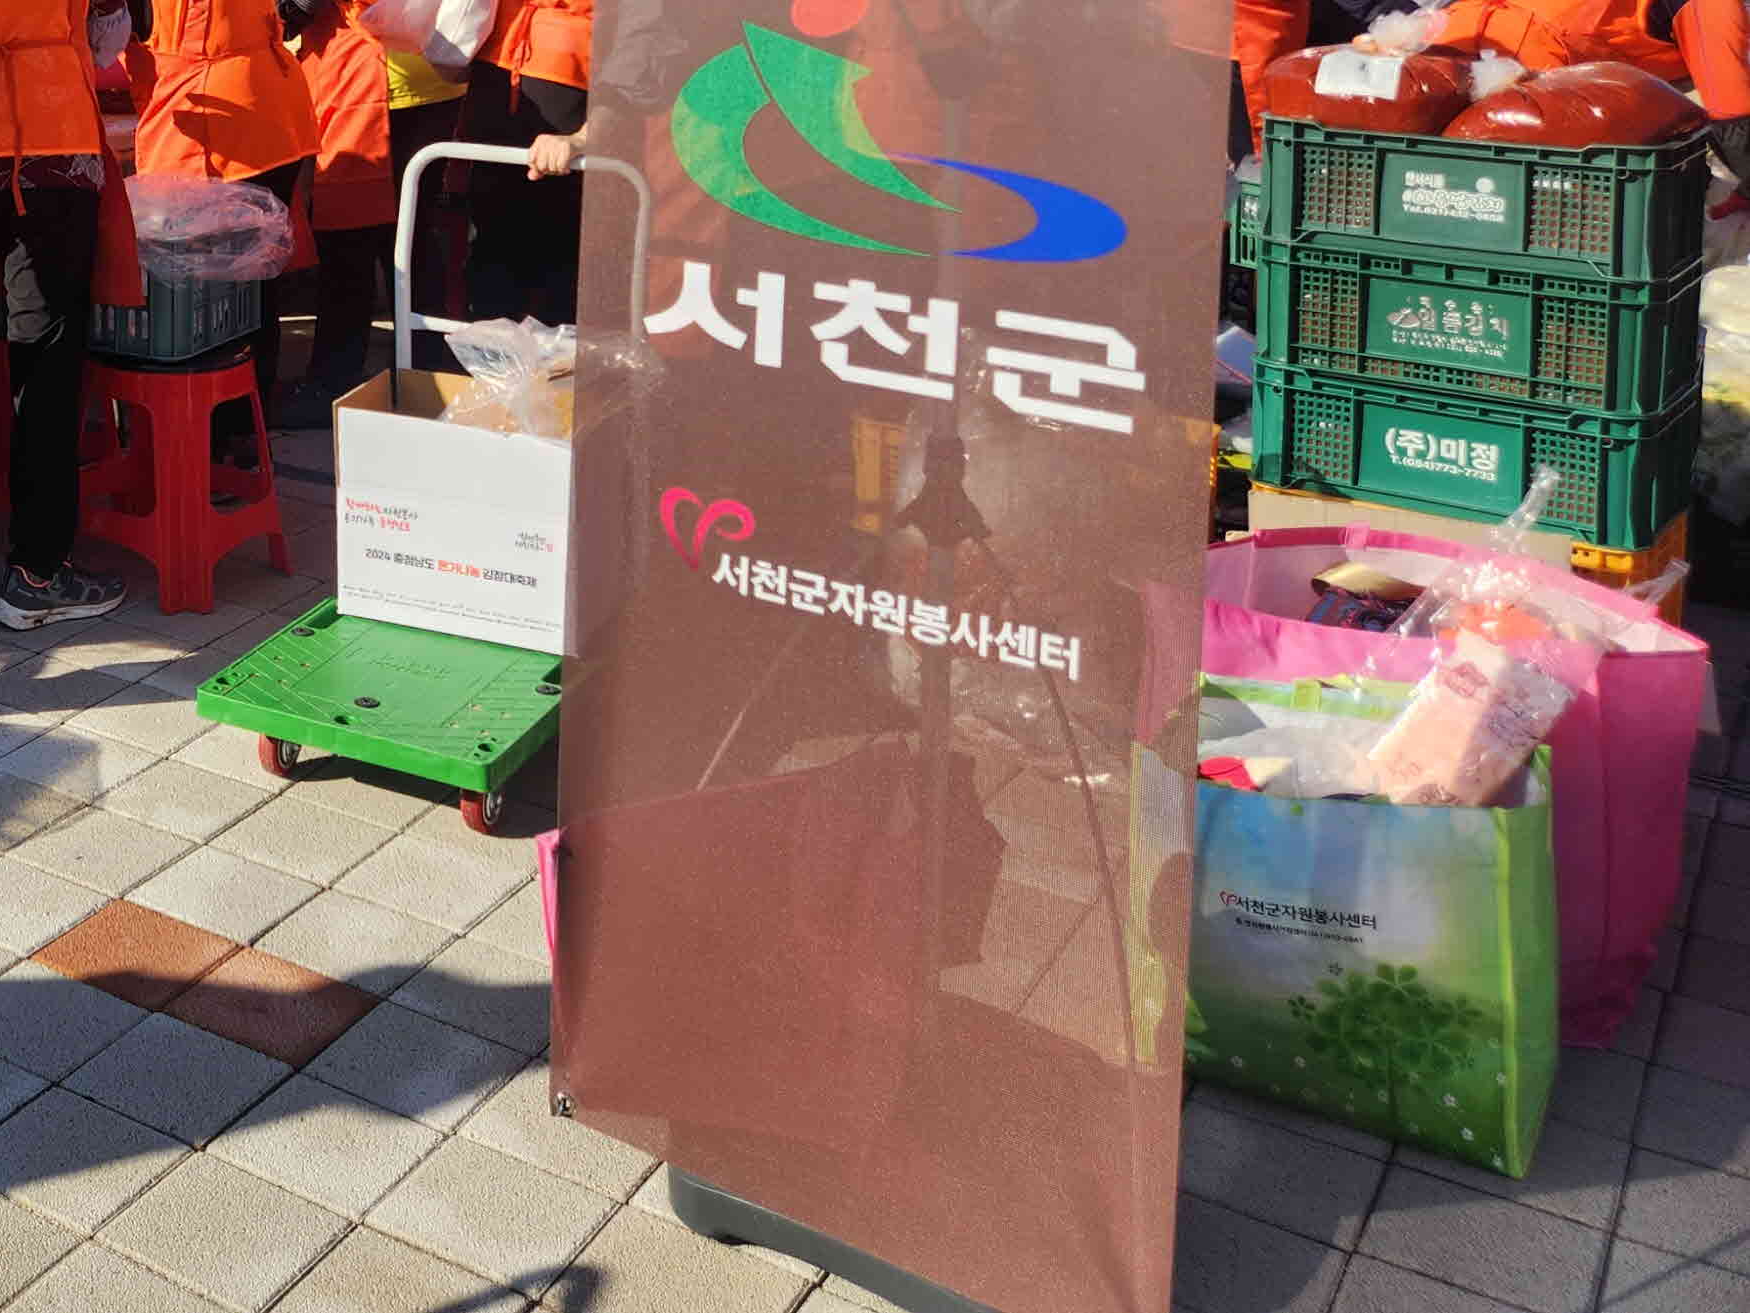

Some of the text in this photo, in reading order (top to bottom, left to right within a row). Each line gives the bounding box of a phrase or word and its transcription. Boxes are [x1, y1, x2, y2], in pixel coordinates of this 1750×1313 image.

[643, 261, 1146, 434] 서천군
[1385, 427, 1499, 471] (주)미정
[365, 548, 539, 588] 2024 충청남도 온기나눔 김장대축제
[712, 552, 1081, 681] 서천군자원봉사센터
[1235, 895, 1378, 930] 서천군자원봉사센터
